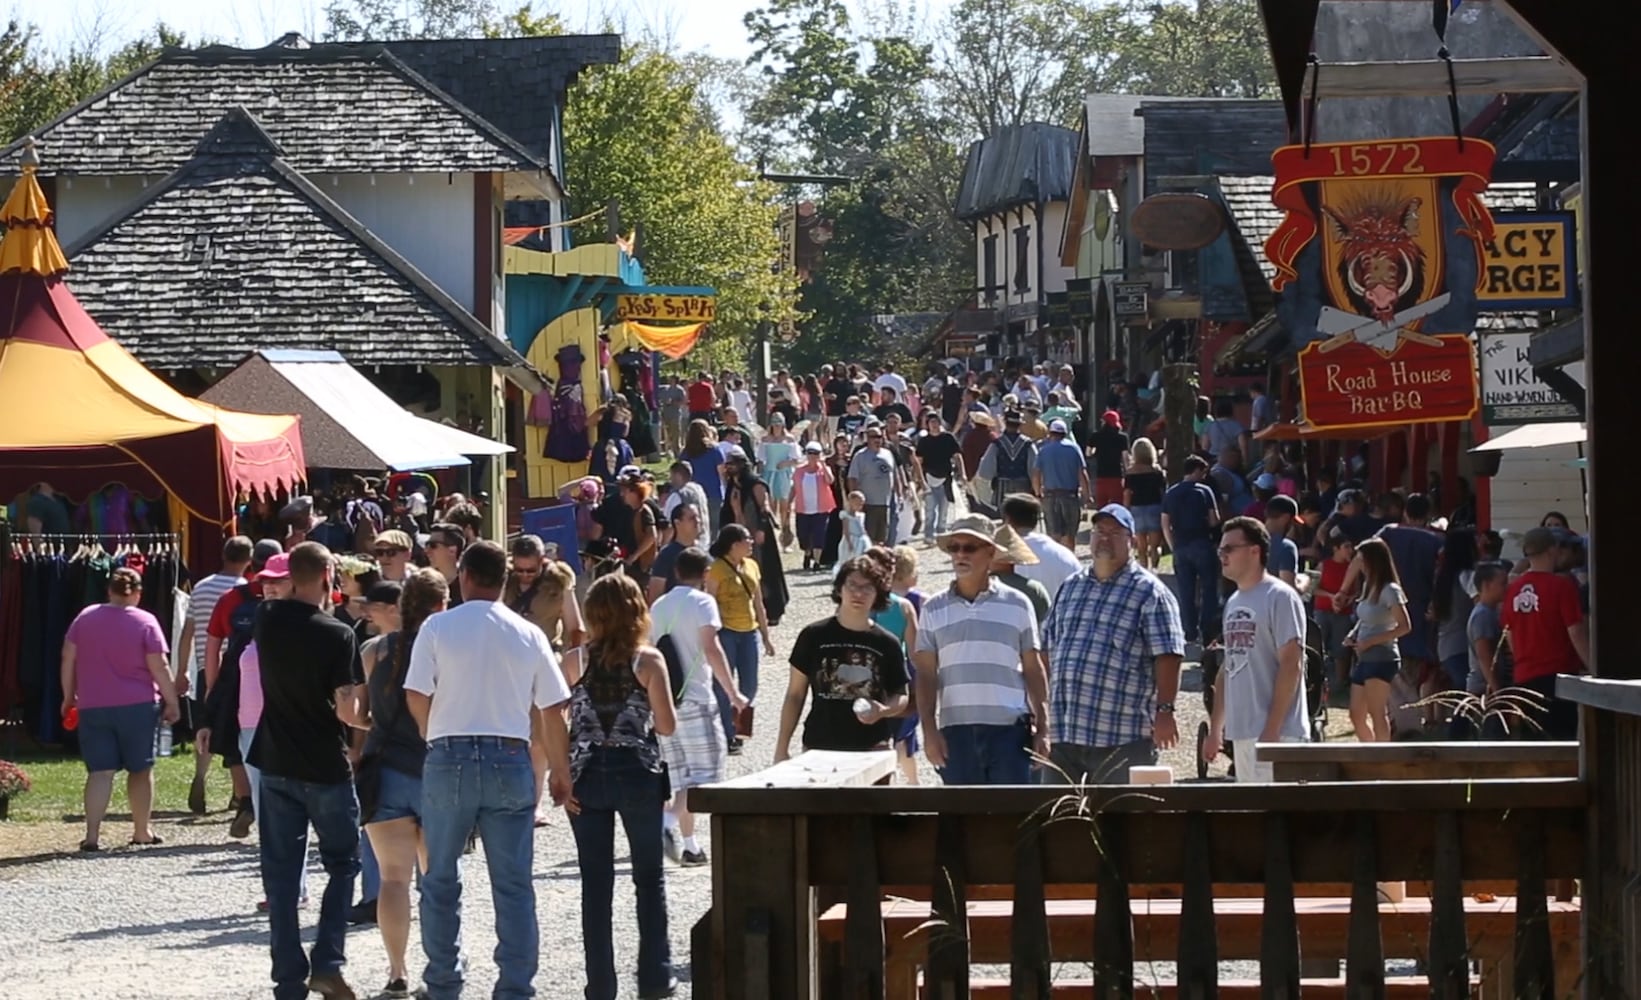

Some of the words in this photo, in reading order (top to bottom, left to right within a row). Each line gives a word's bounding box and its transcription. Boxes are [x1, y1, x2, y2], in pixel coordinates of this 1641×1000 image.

[1329, 143, 1425, 176] 1572
[1484, 340, 1507, 357] THE
[1326, 364, 1377, 394] Road
[1390, 361, 1452, 386] House
